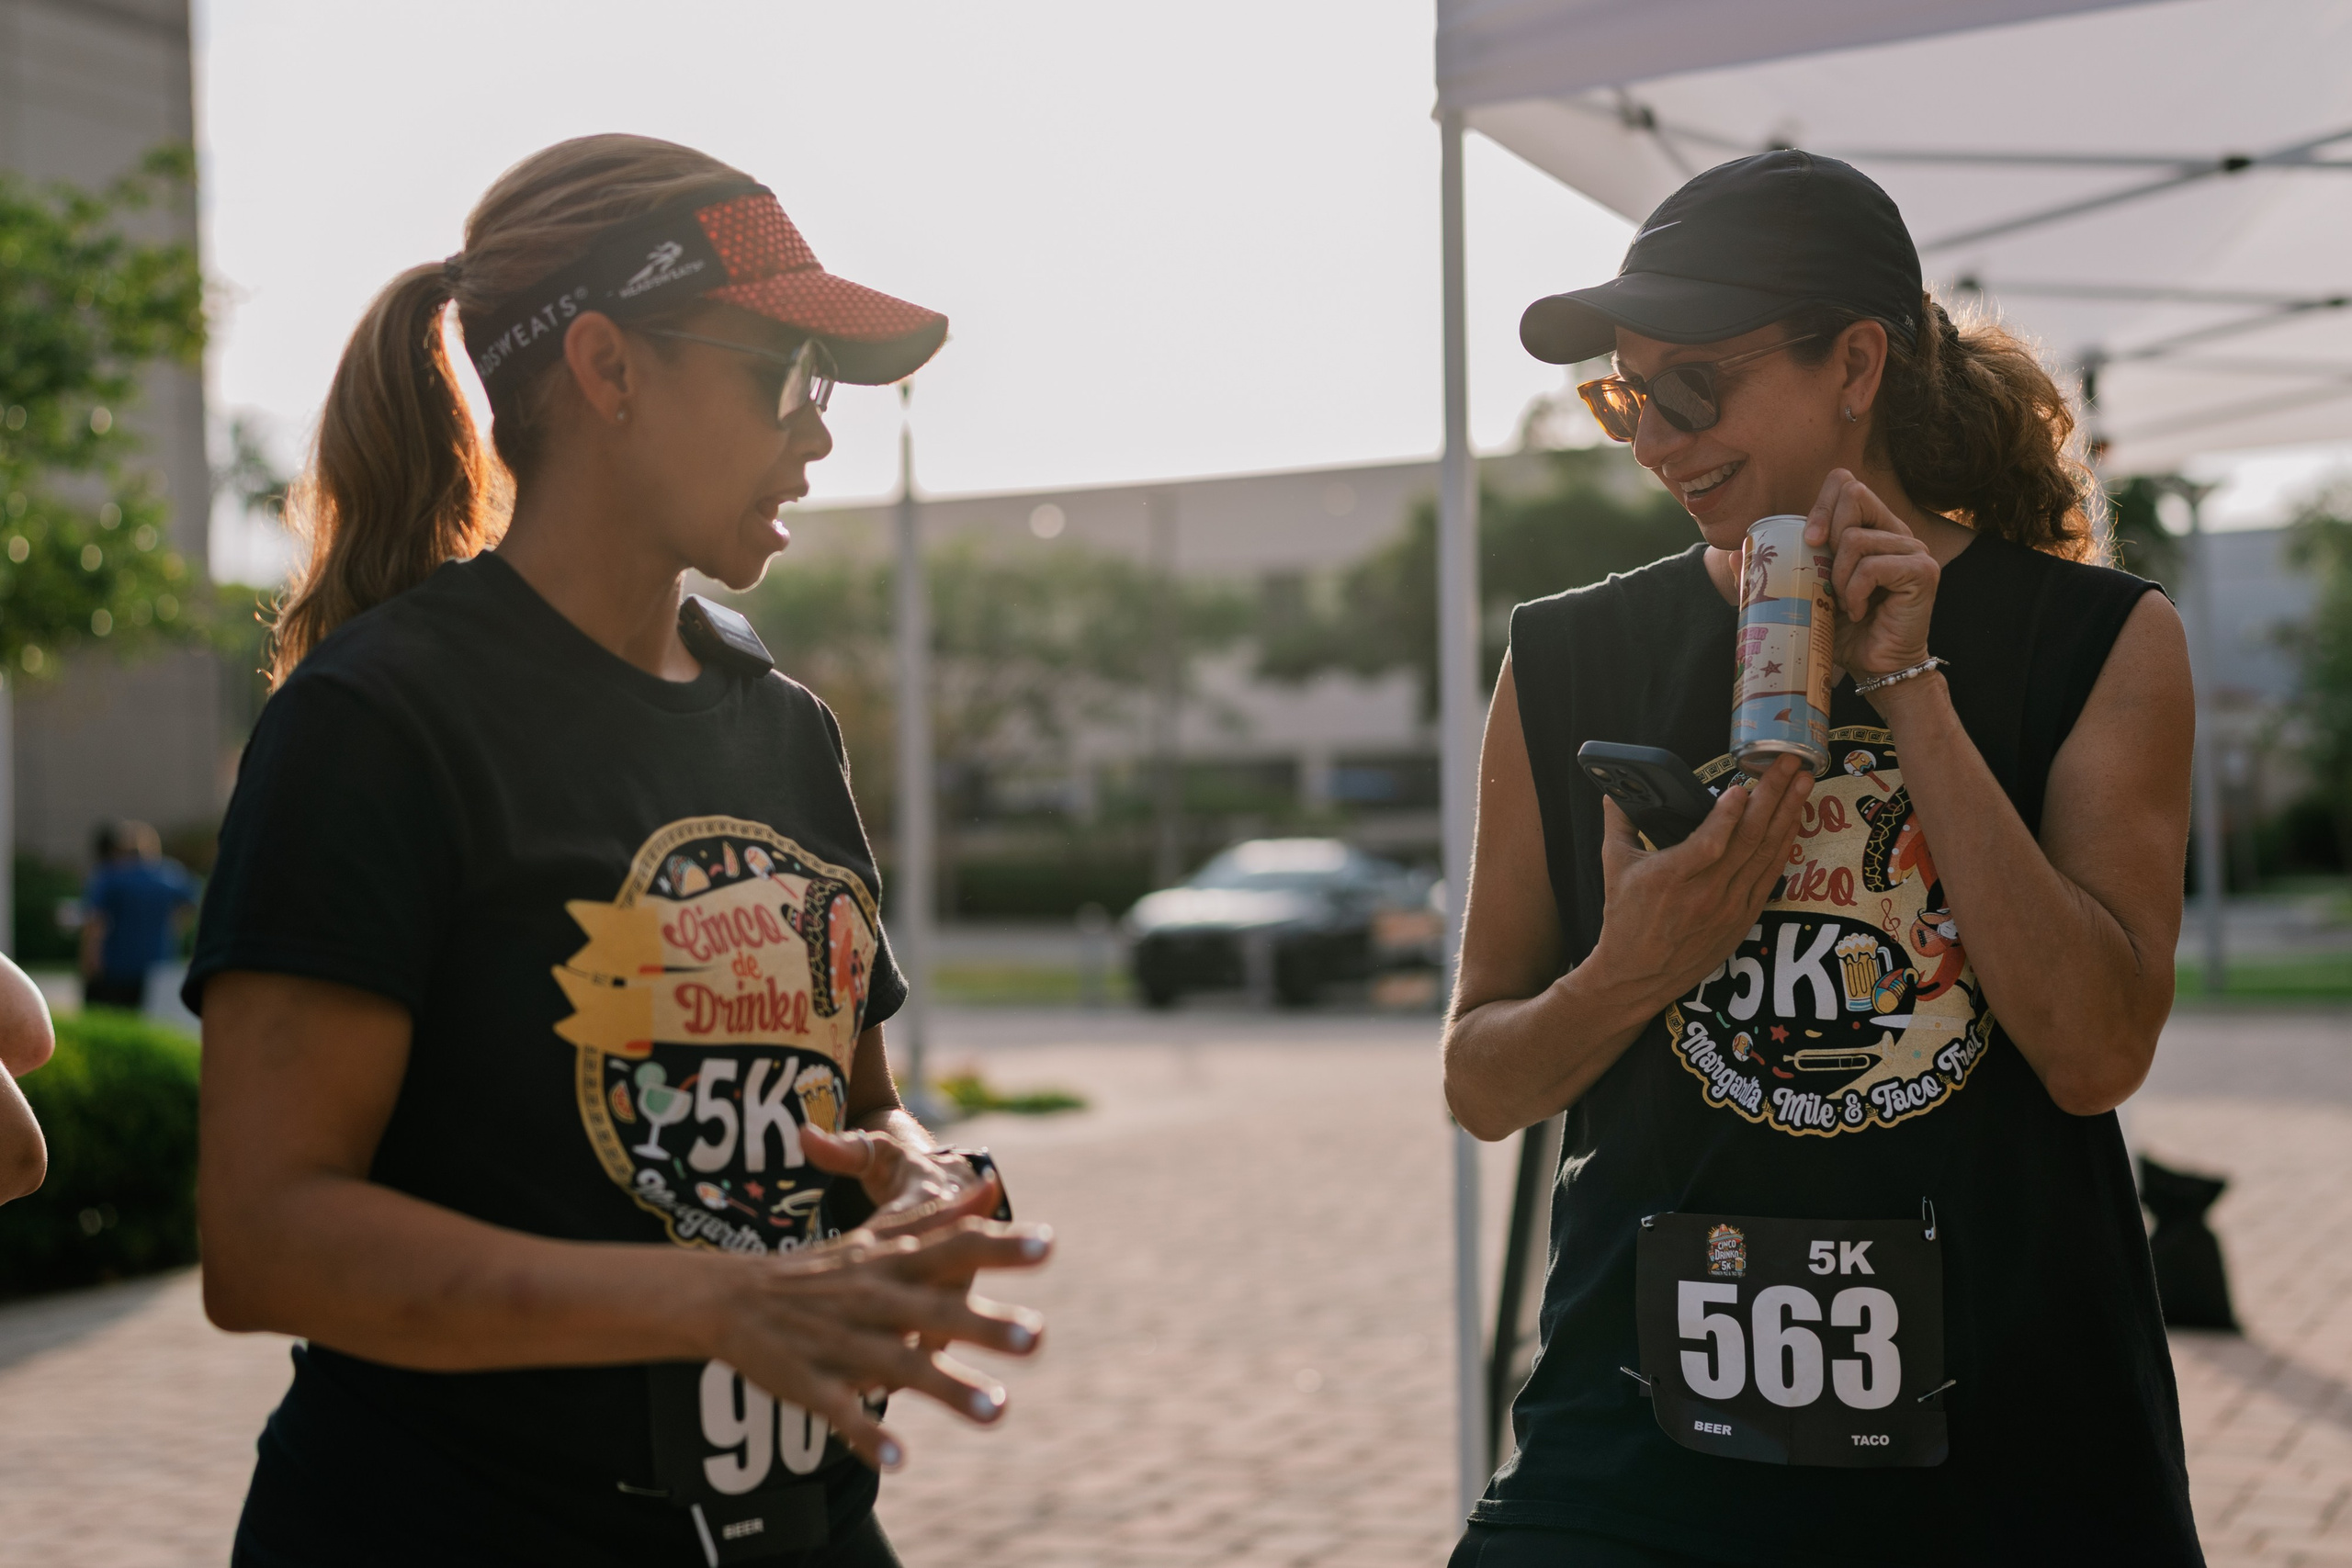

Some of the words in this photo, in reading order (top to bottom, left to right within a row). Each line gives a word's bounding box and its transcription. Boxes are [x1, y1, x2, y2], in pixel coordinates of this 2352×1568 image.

[662, 903, 789, 963] Cinco
[731, 950, 763, 981] de
[1727, 922, 1840, 1021] 5K
[673, 977, 811, 1036] Drinko
[1773, 1088, 1837, 1128] Mile
[1844, 1093, 1862, 1124] &
[1871, 1076, 1943, 1119] Taco
[1937, 1024, 1983, 1081] Trot
[687, 1056, 807, 1174] 5K
[1718, 1239, 1736, 1250] CINCO
[1807, 1240, 1876, 1276] 5K
[1677, 1280, 1902, 1410] 563
[1693, 1420, 1733, 1437] BEER
[1850, 1434, 1890, 1447] TACO
[722, 1517, 764, 1540] BEER
